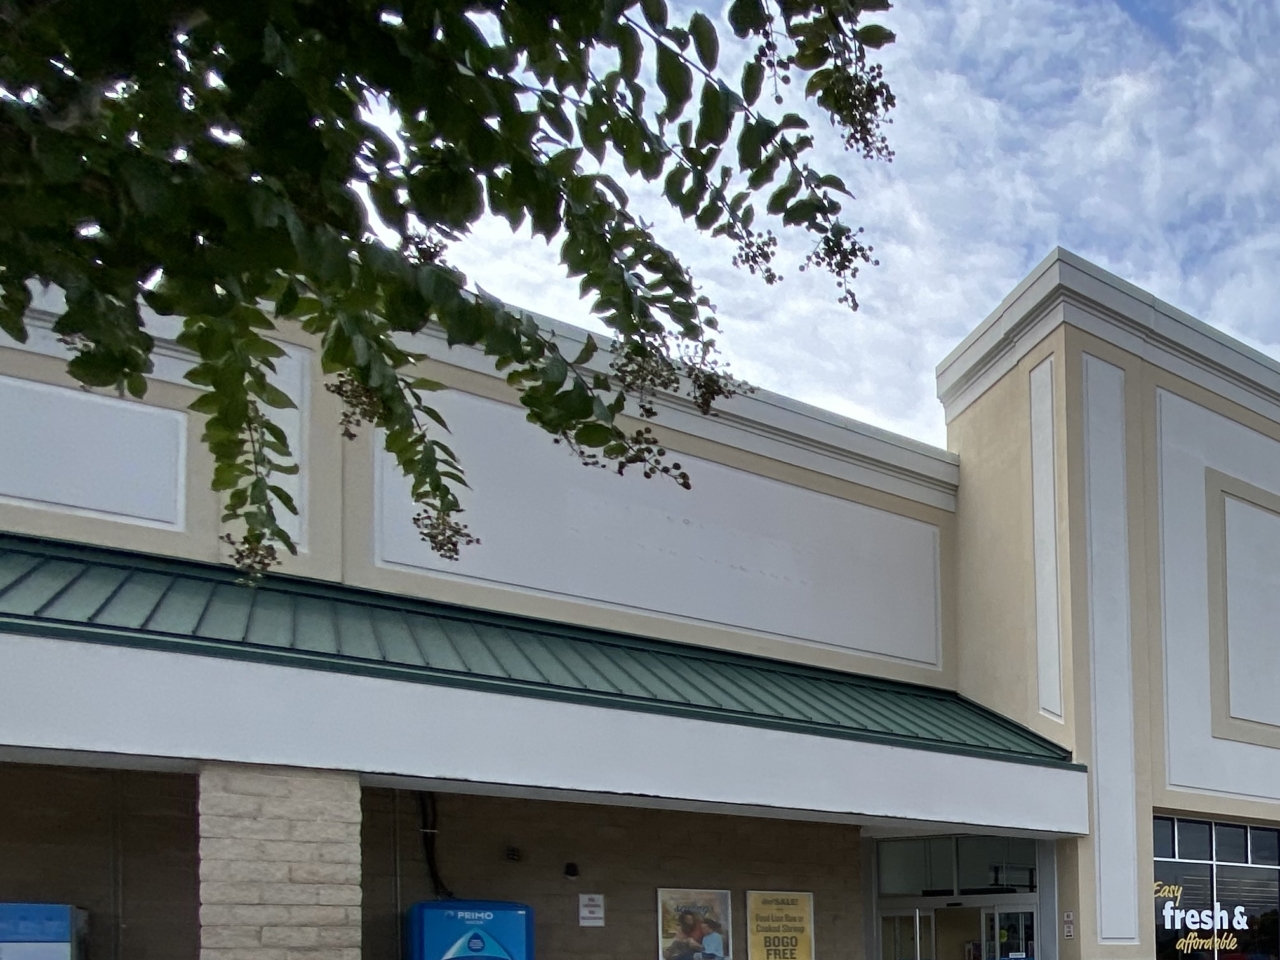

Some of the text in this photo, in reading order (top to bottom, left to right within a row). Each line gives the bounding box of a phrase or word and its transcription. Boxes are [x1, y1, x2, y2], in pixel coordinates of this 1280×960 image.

[1153, 881, 1183, 907] Easy
[457, 911, 494, 920] PRIMO
[1162, 900, 1249, 930] fresh &
[763, 935, 798, 948] BOGO
[1175, 932, 1238, 954] affordable
[766, 948, 797, 960] FREE
